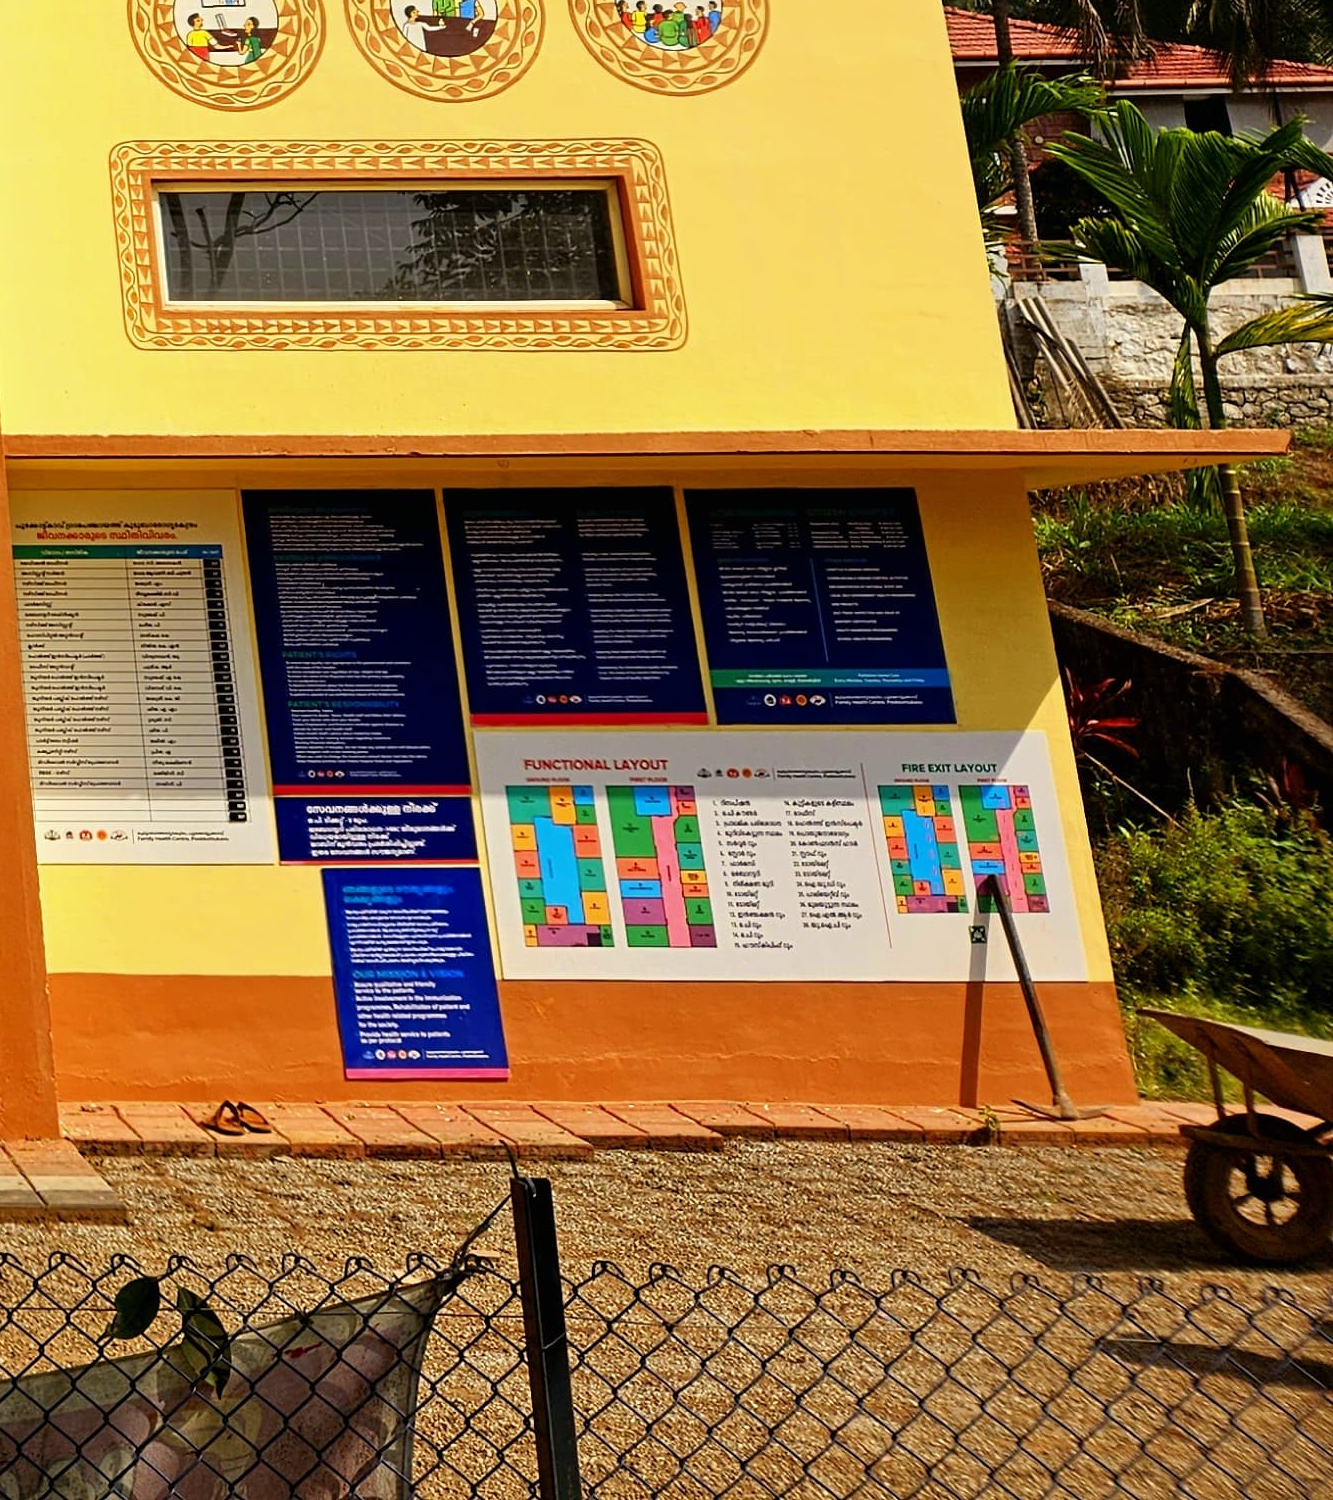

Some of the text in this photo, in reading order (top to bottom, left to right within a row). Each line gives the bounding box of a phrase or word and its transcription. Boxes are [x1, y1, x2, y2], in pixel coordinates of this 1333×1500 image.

[524, 759, 668, 770] FUNCTIONAL LAYOUT
[902, 764, 997, 773] FIRE EXIT LAYOUT
[376, 970, 419, 979] MISSION
[428, 970, 465, 978] VISION
